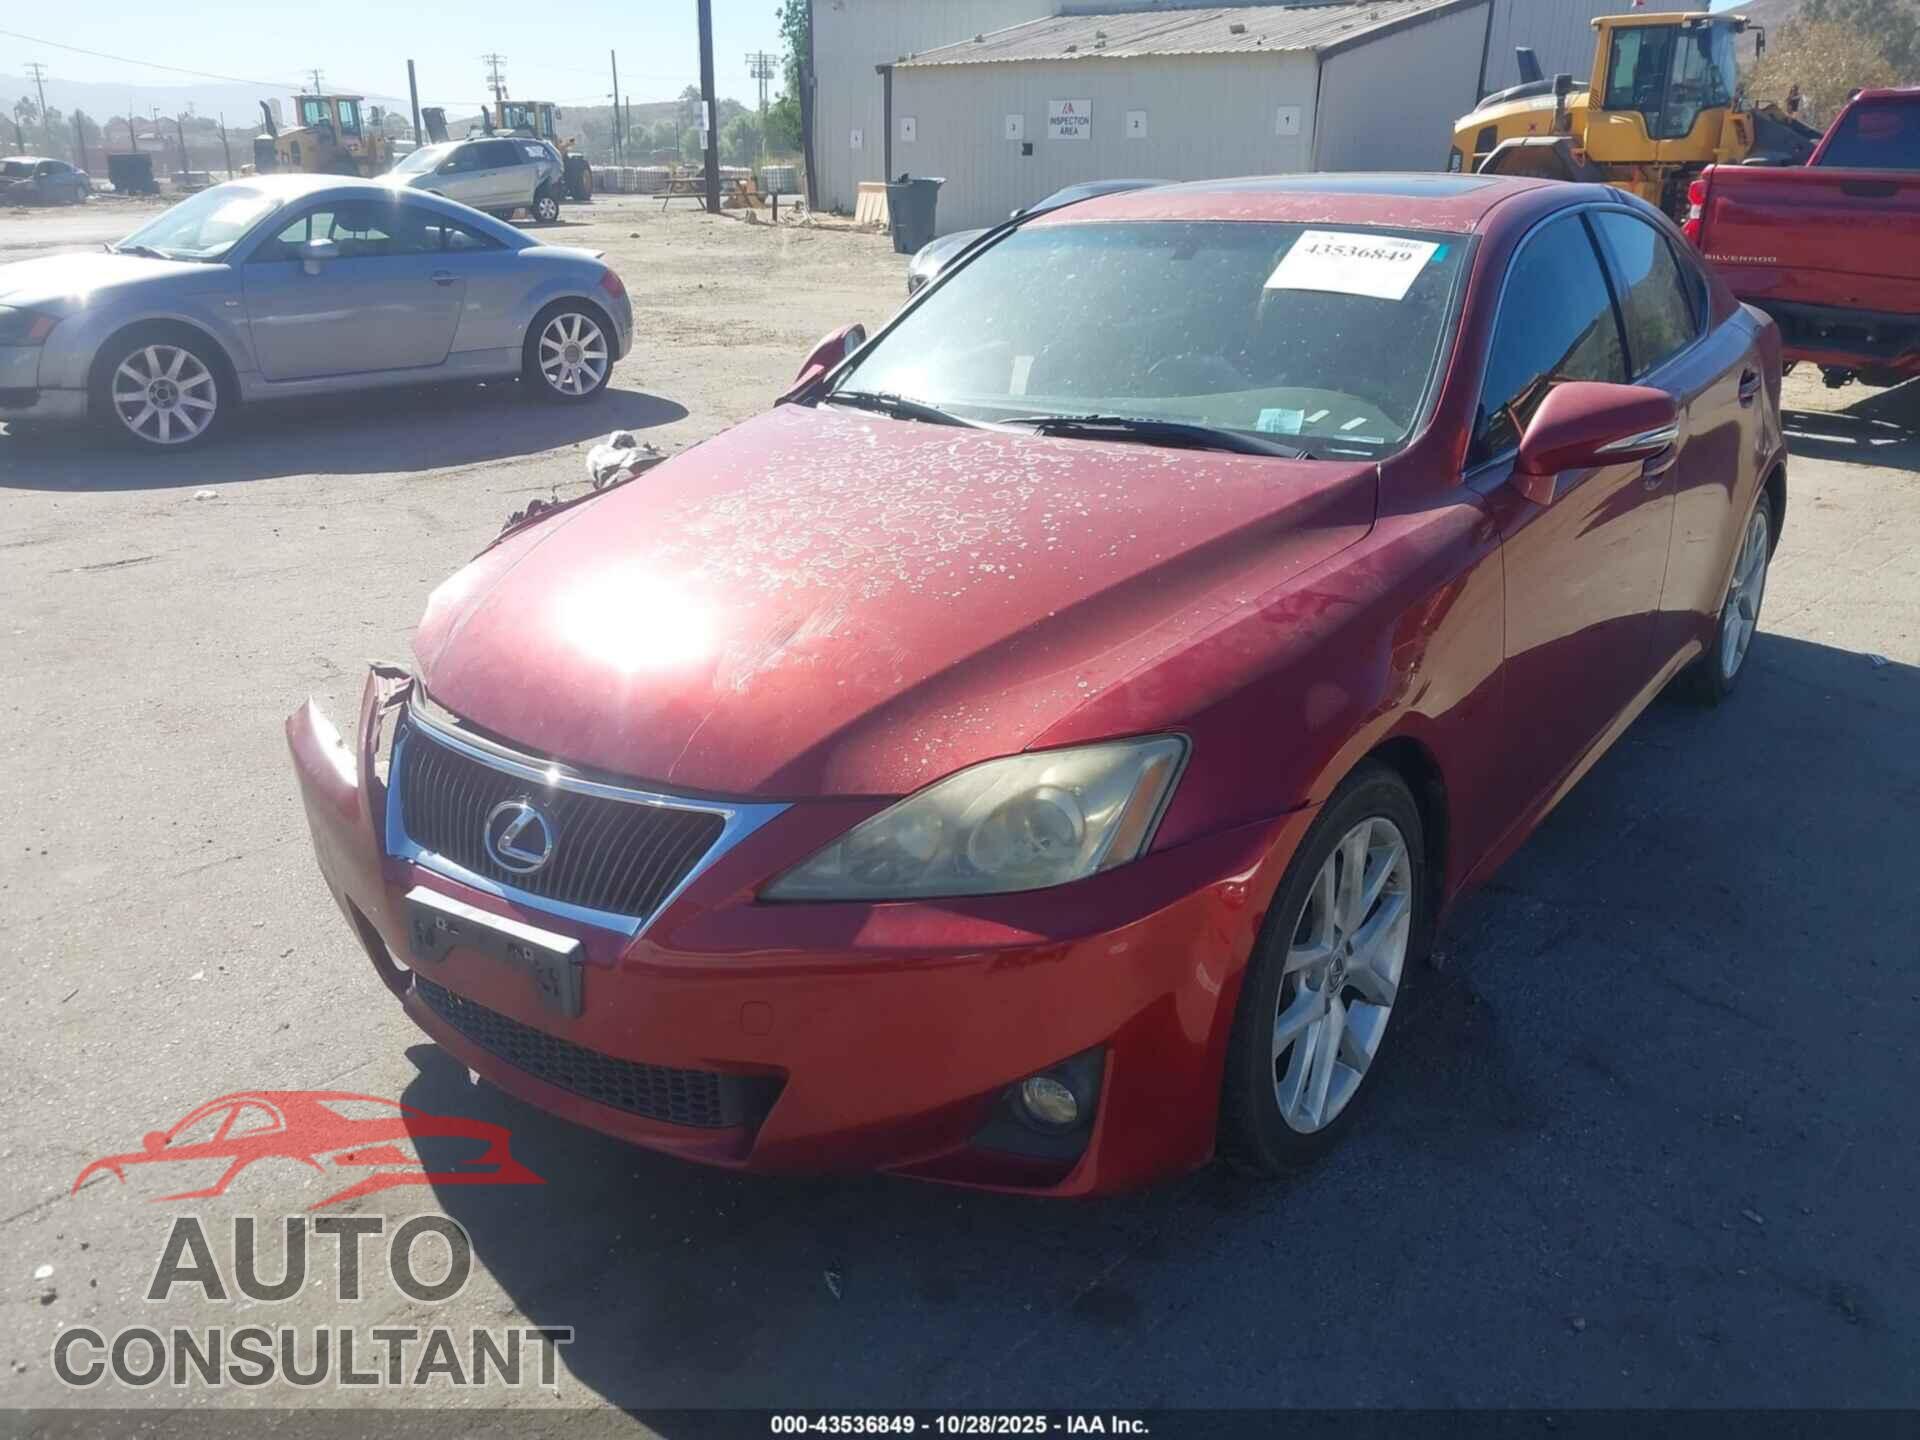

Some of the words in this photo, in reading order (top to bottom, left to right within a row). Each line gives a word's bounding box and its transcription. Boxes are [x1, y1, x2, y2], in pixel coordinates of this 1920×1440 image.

[1049, 116, 1089, 126] INSPECTION
[1060, 127, 1078, 136] AREA
[1304, 242, 1413, 262] 43536849
[1704, 254, 1777, 263] SILVERADO
